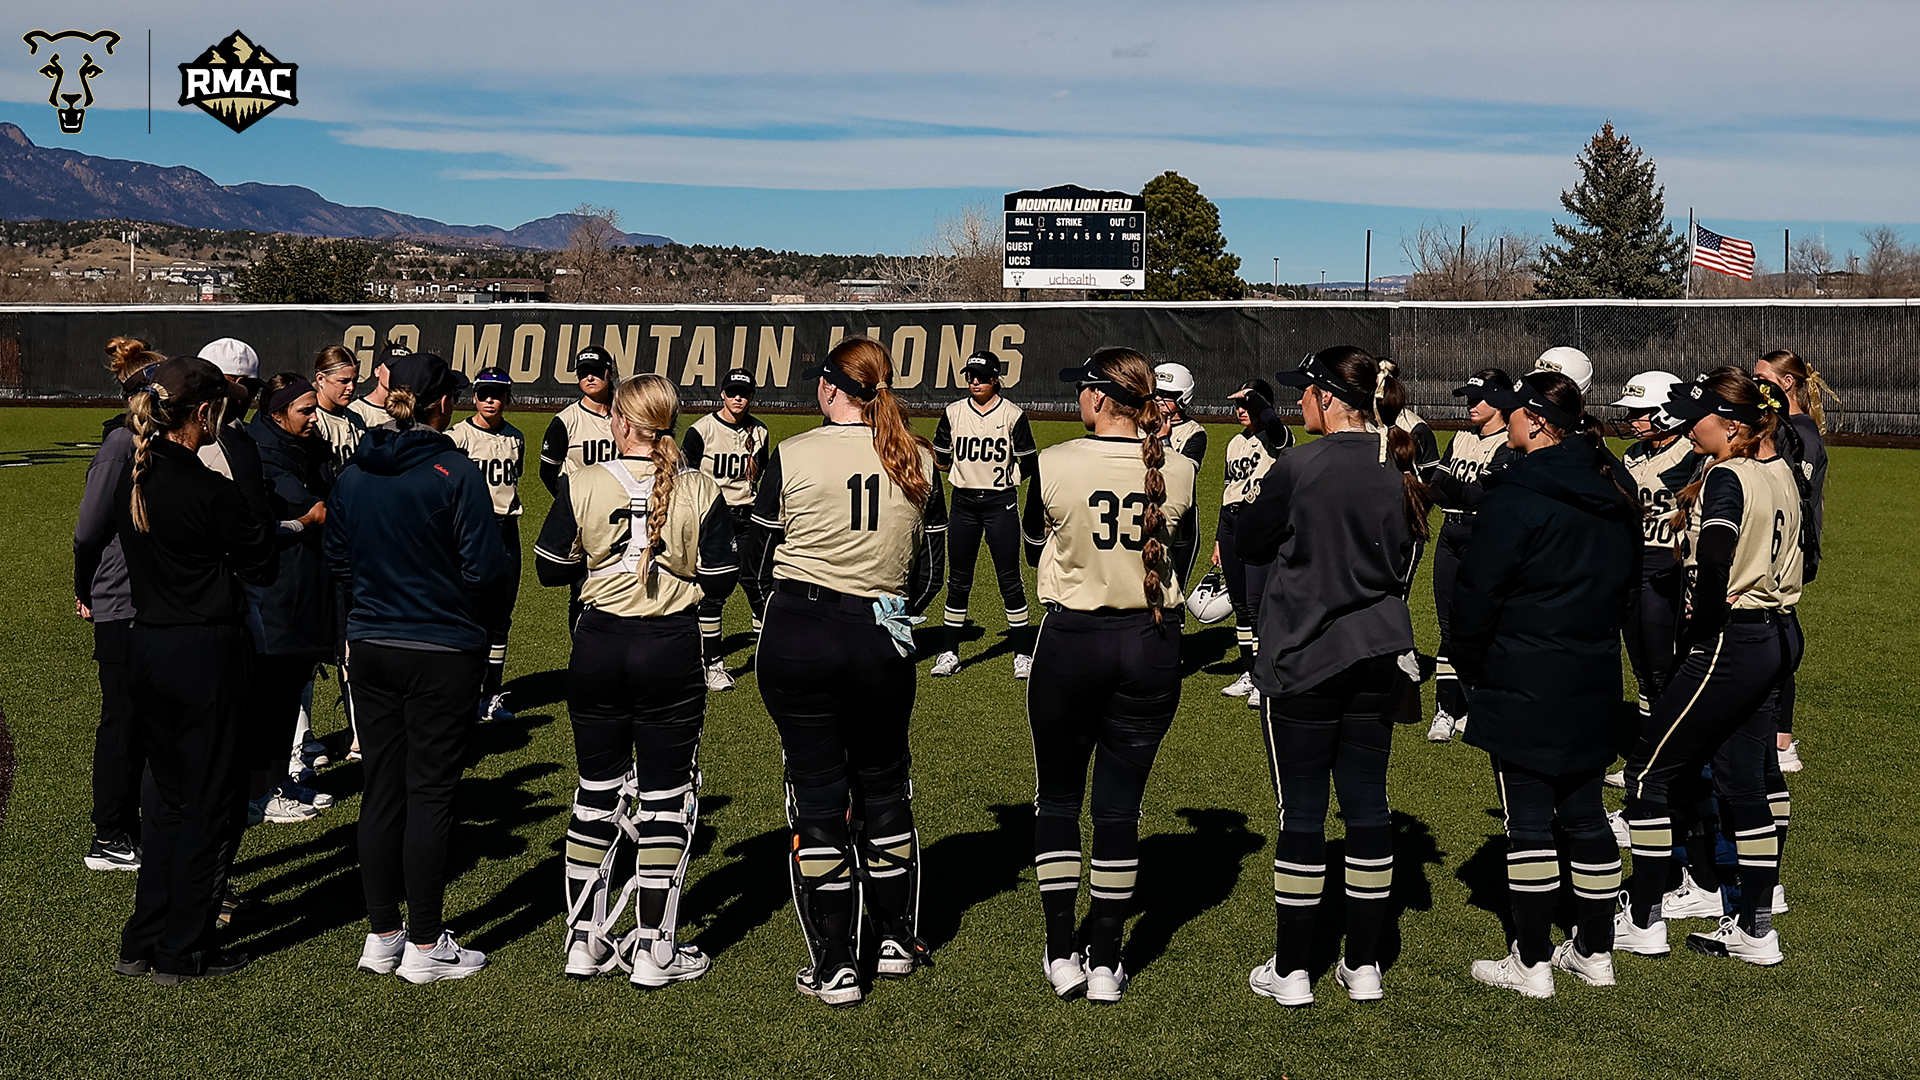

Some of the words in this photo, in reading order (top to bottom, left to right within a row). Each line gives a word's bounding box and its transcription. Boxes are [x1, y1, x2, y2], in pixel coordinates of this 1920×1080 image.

[1015, 198, 1073, 211] MOUNTAIN
[1074, 198, 1100, 211] LION
[1101, 198, 1133, 211] FIELD
[1014, 217, 1034, 226] BALL
[1055, 217, 1083, 227] STRIKE
[1109, 217, 1126, 227] OUT
[1128, 216, 1137, 229] 0
[1037, 232, 1042, 241] 1
[1048, 232, 1054, 241] 2
[1059, 232, 1065, 241] 3
[1073, 232, 1079, 241] 4
[1084, 232, 1090, 241] 5
[1096, 232, 1102, 241] 6
[1109, 232, 1115, 241] 7
[1121, 232, 1141, 241] RUNS
[1006, 241, 1034, 252] GUEST
[1132, 241, 1140, 254] 0
[1008, 256, 1031, 266] UCCS
[1131, 255, 1140, 268] 0
[1048, 272, 1097, 286] uchealth
[451, 323, 796, 388] MOUNTAIN
[829, 322, 1026, 389] ONS
[955, 436, 1008, 462] UCCS
[846, 472, 881, 533] 11
[1088, 489, 1149, 552] 33
[1770, 508, 1785, 564] 6
